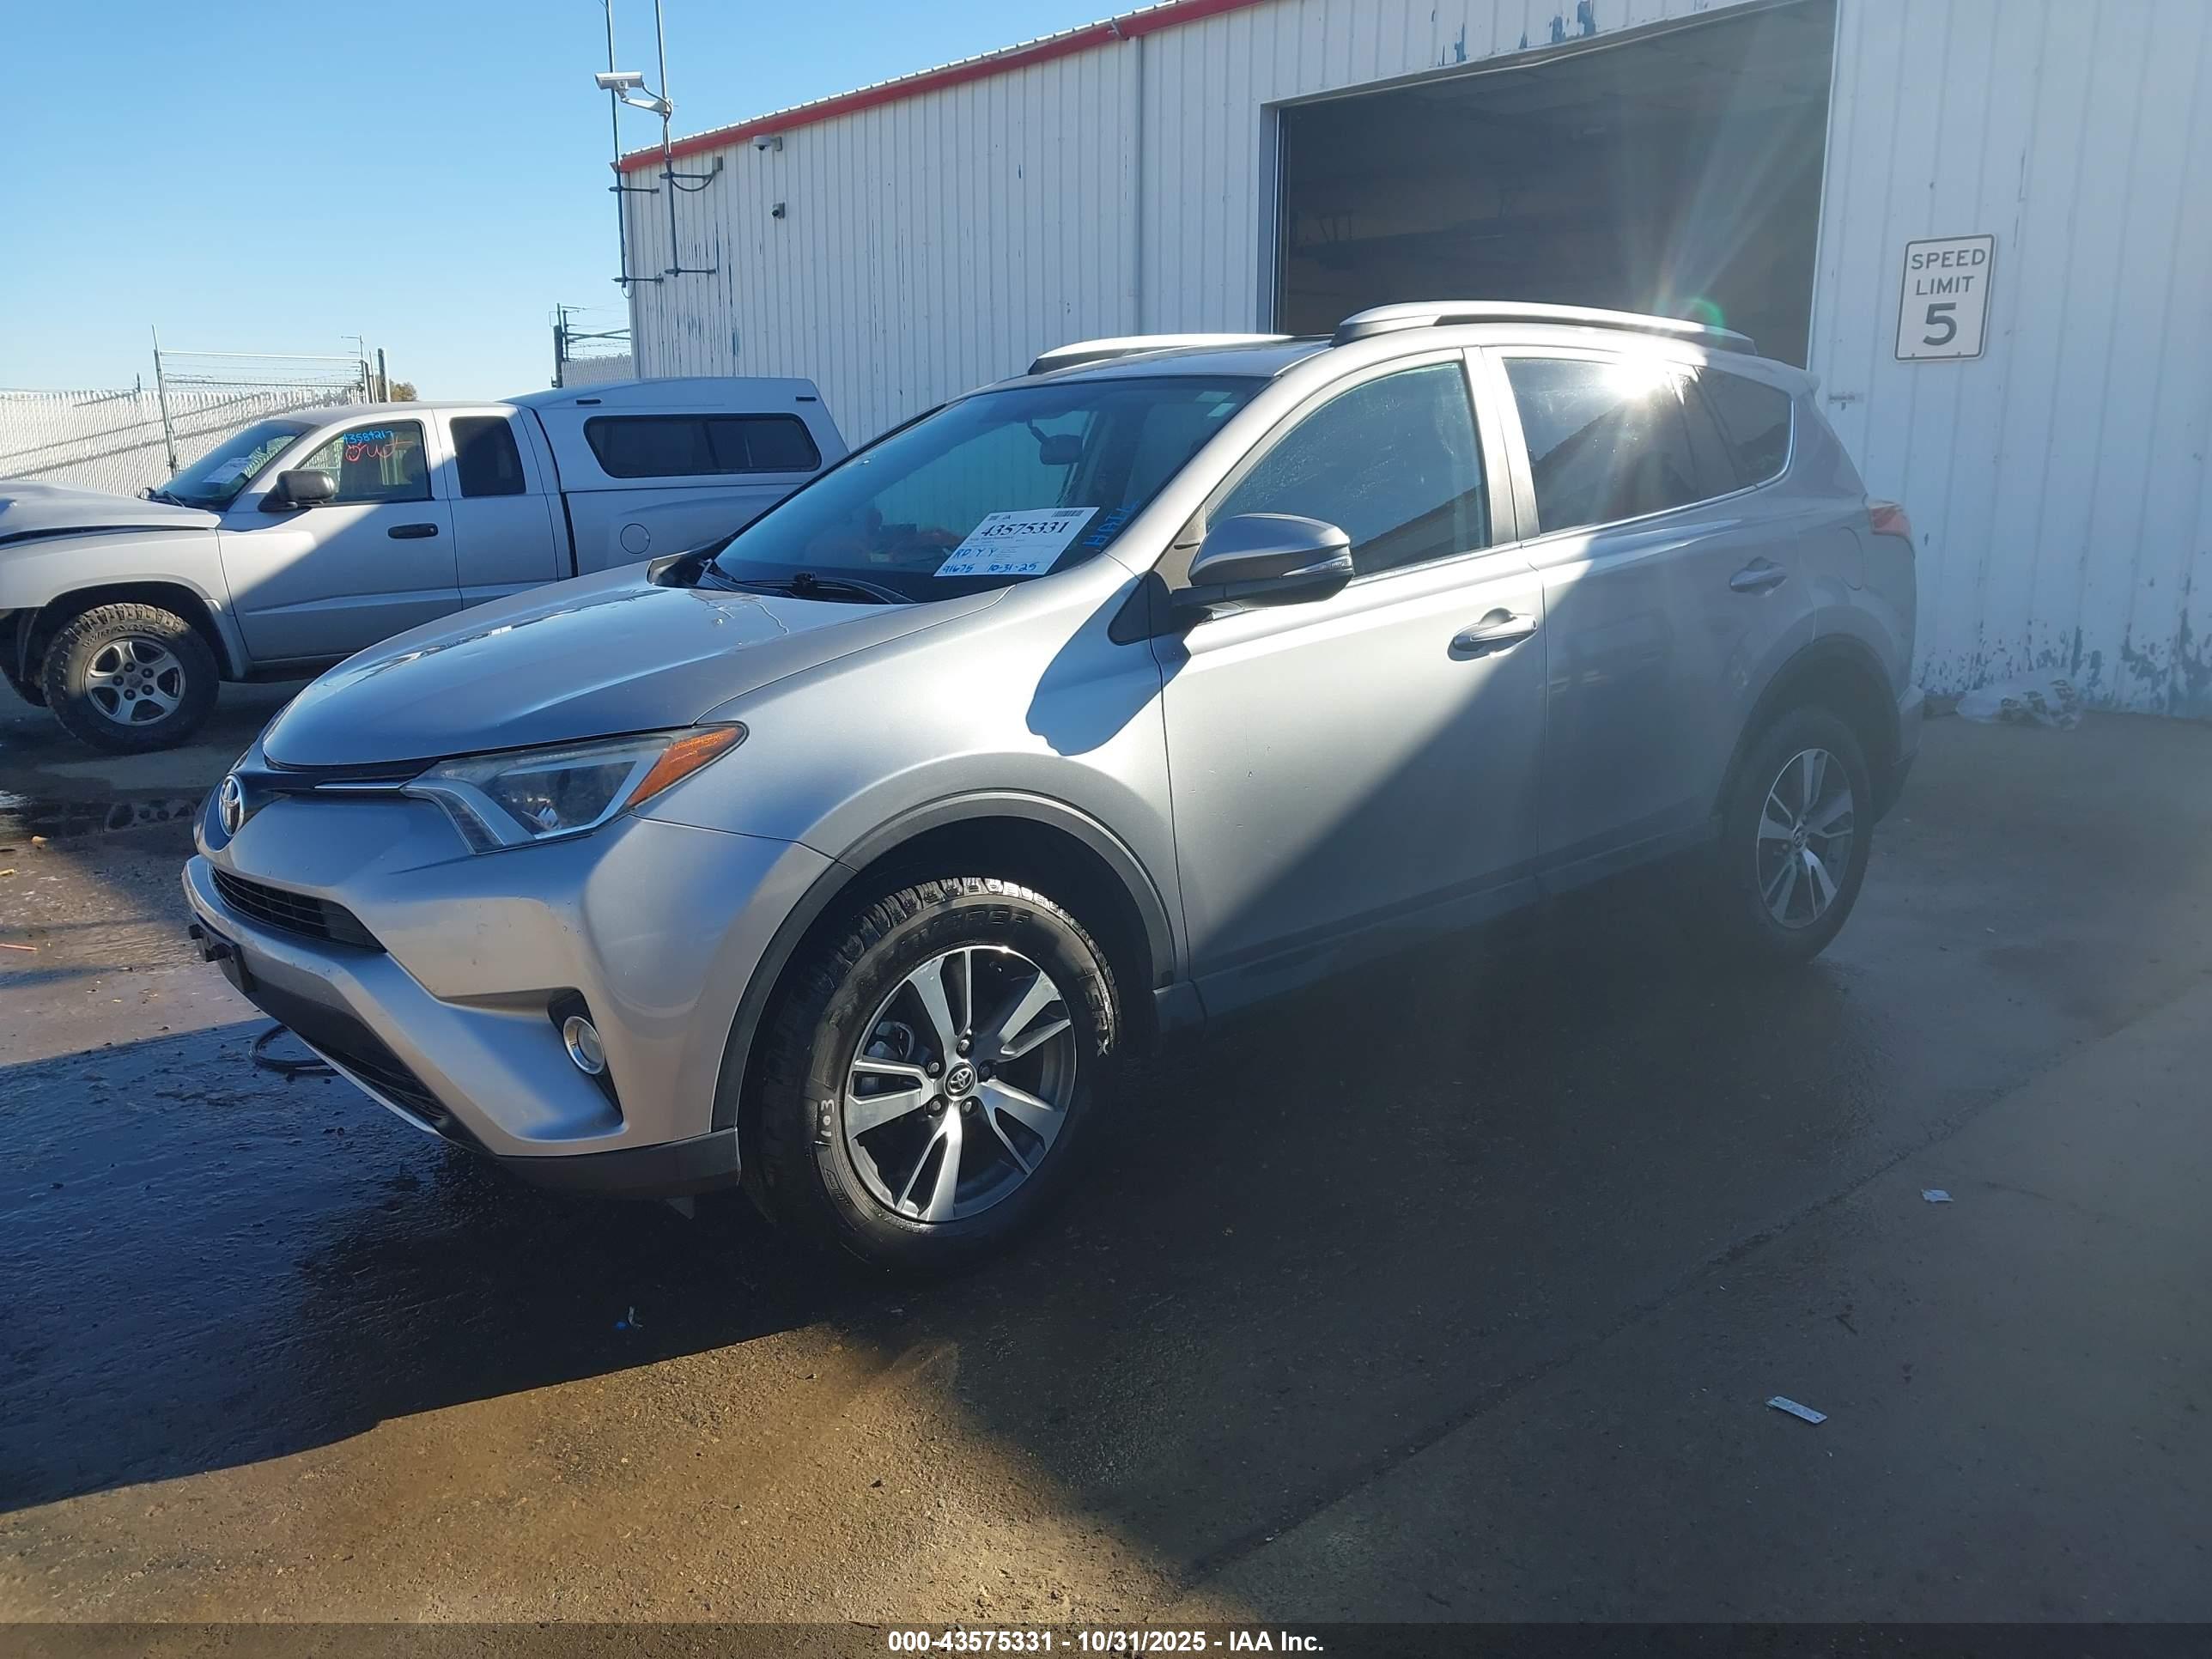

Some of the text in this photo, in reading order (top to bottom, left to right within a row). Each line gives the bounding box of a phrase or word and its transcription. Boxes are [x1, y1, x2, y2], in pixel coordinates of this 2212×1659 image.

[1911, 248, 1986, 270] SPEED
[1916, 276, 1975, 296] LIMIT
[1923, 301, 1958, 346] 5
[981, 521, 1070, 538] 43575331
